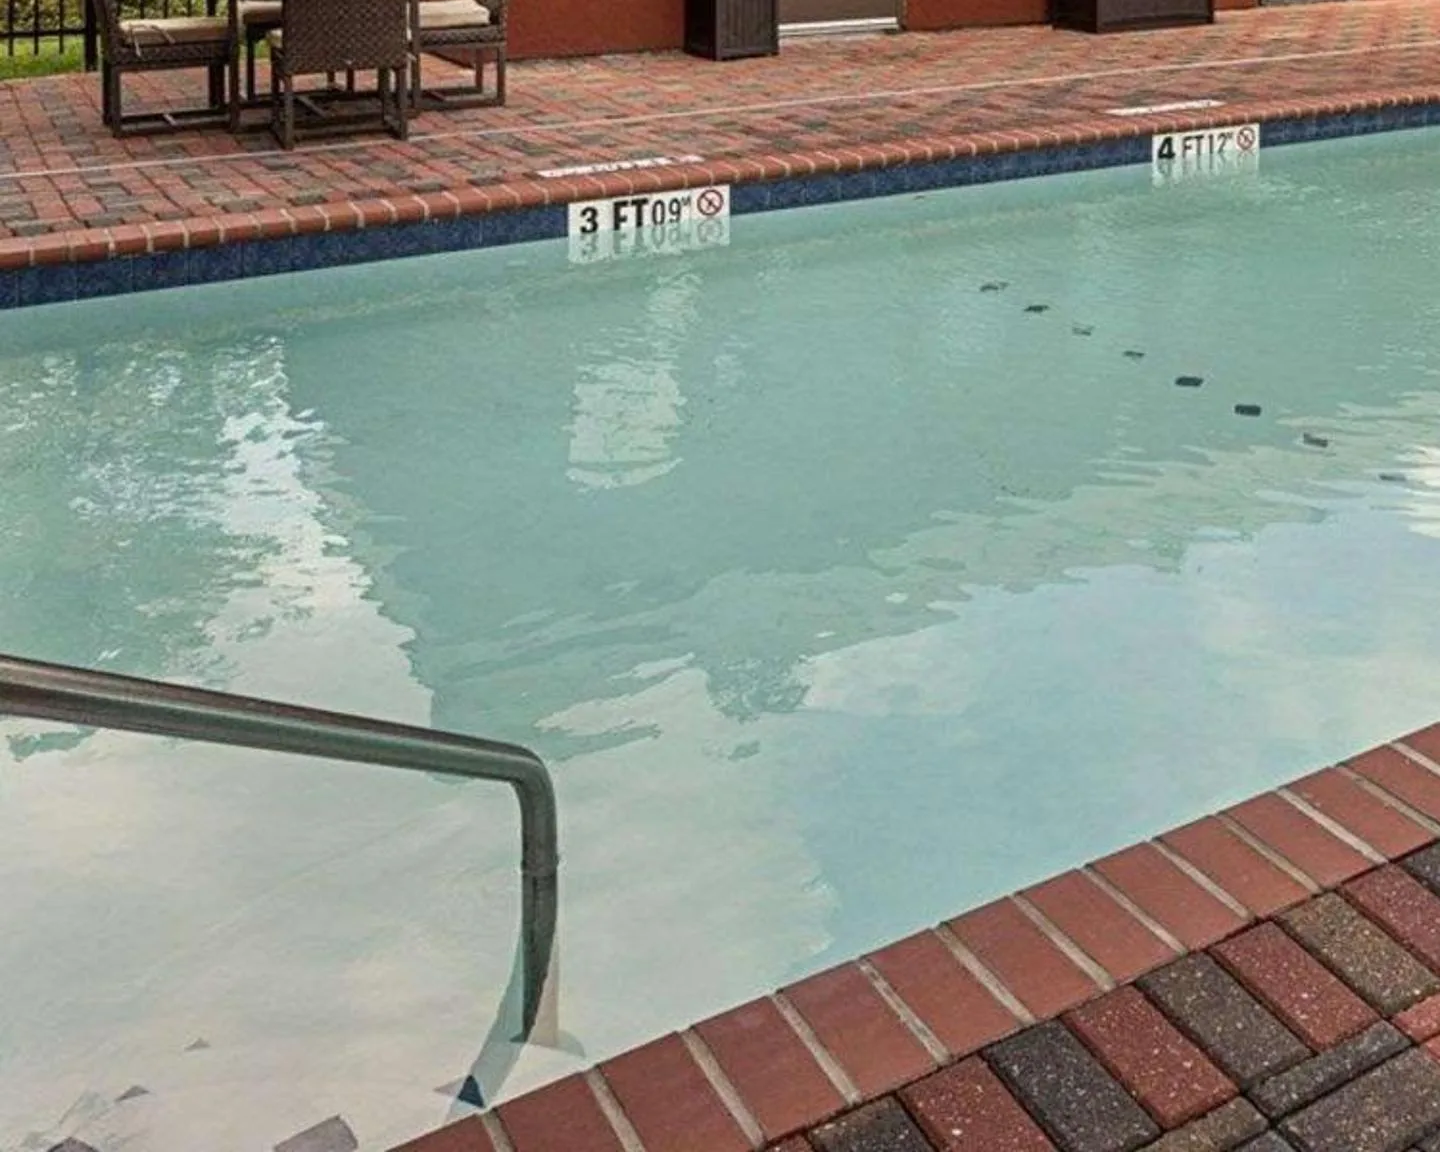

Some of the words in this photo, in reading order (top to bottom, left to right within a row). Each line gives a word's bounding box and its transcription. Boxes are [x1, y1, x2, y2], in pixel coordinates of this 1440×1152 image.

[1157, 136, 1175, 159] 4
[1182, 135, 1204, 157] FT
[580, 207, 598, 234] 3
[613, 198, 649, 231] FT
